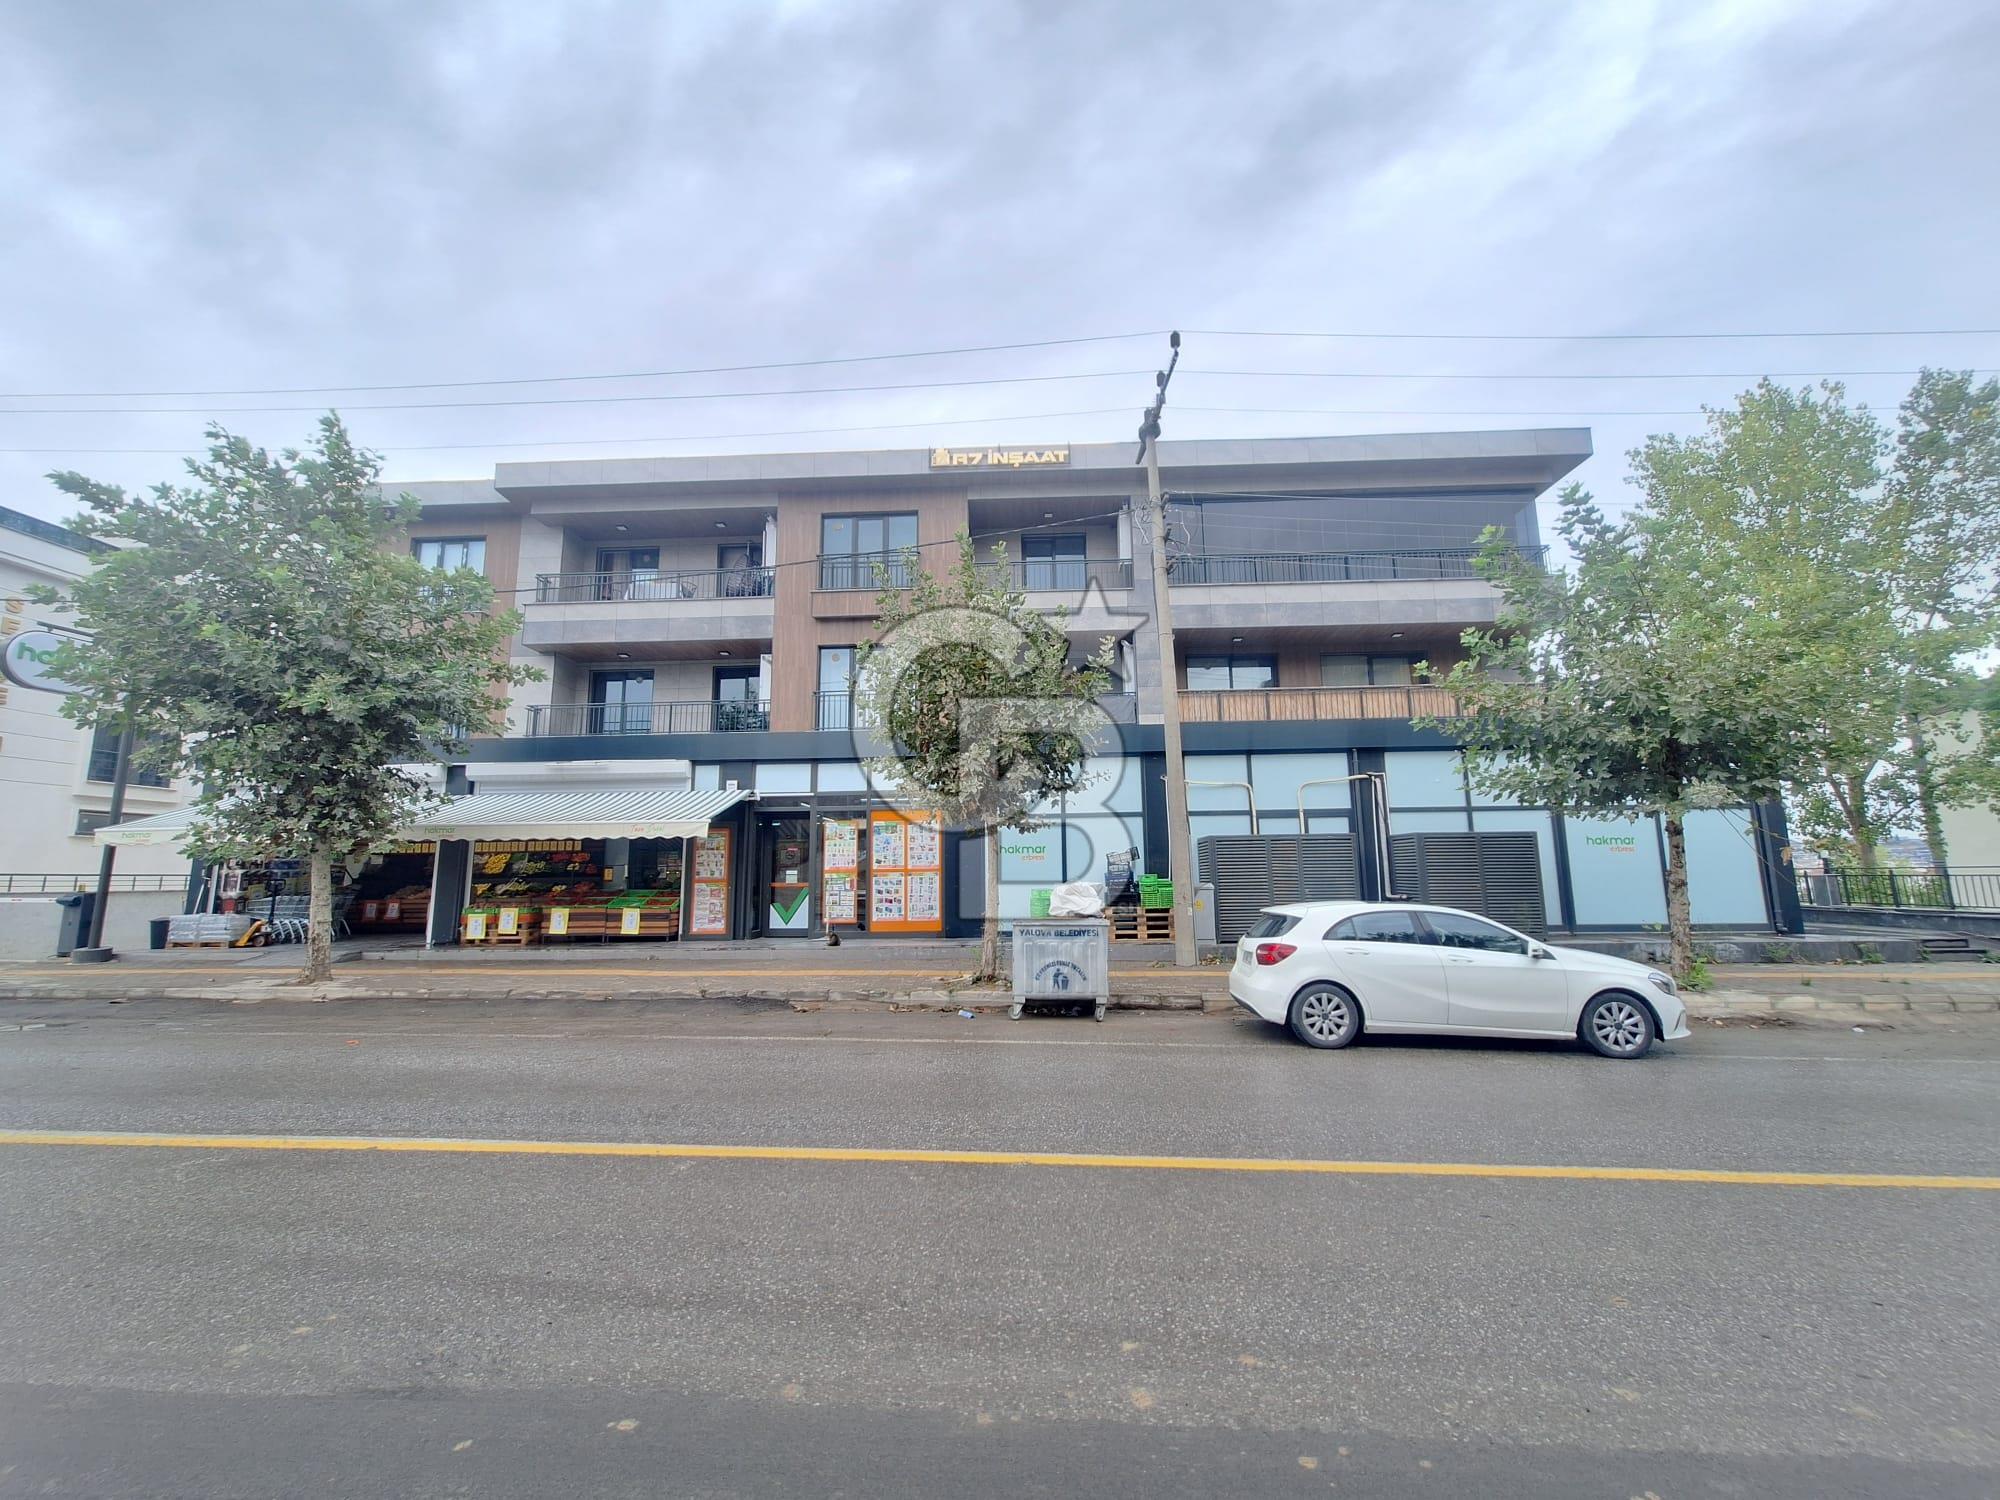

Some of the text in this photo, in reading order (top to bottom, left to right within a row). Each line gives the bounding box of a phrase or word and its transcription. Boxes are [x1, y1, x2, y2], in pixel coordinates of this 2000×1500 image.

[987, 449, 1069, 467] İNŞAAT
[1586, 835, 1635, 846] hakmar
[999, 844, 1046, 854] hakmar
[1019, 927, 1099, 938] YALOVA BELEDİYESİ
